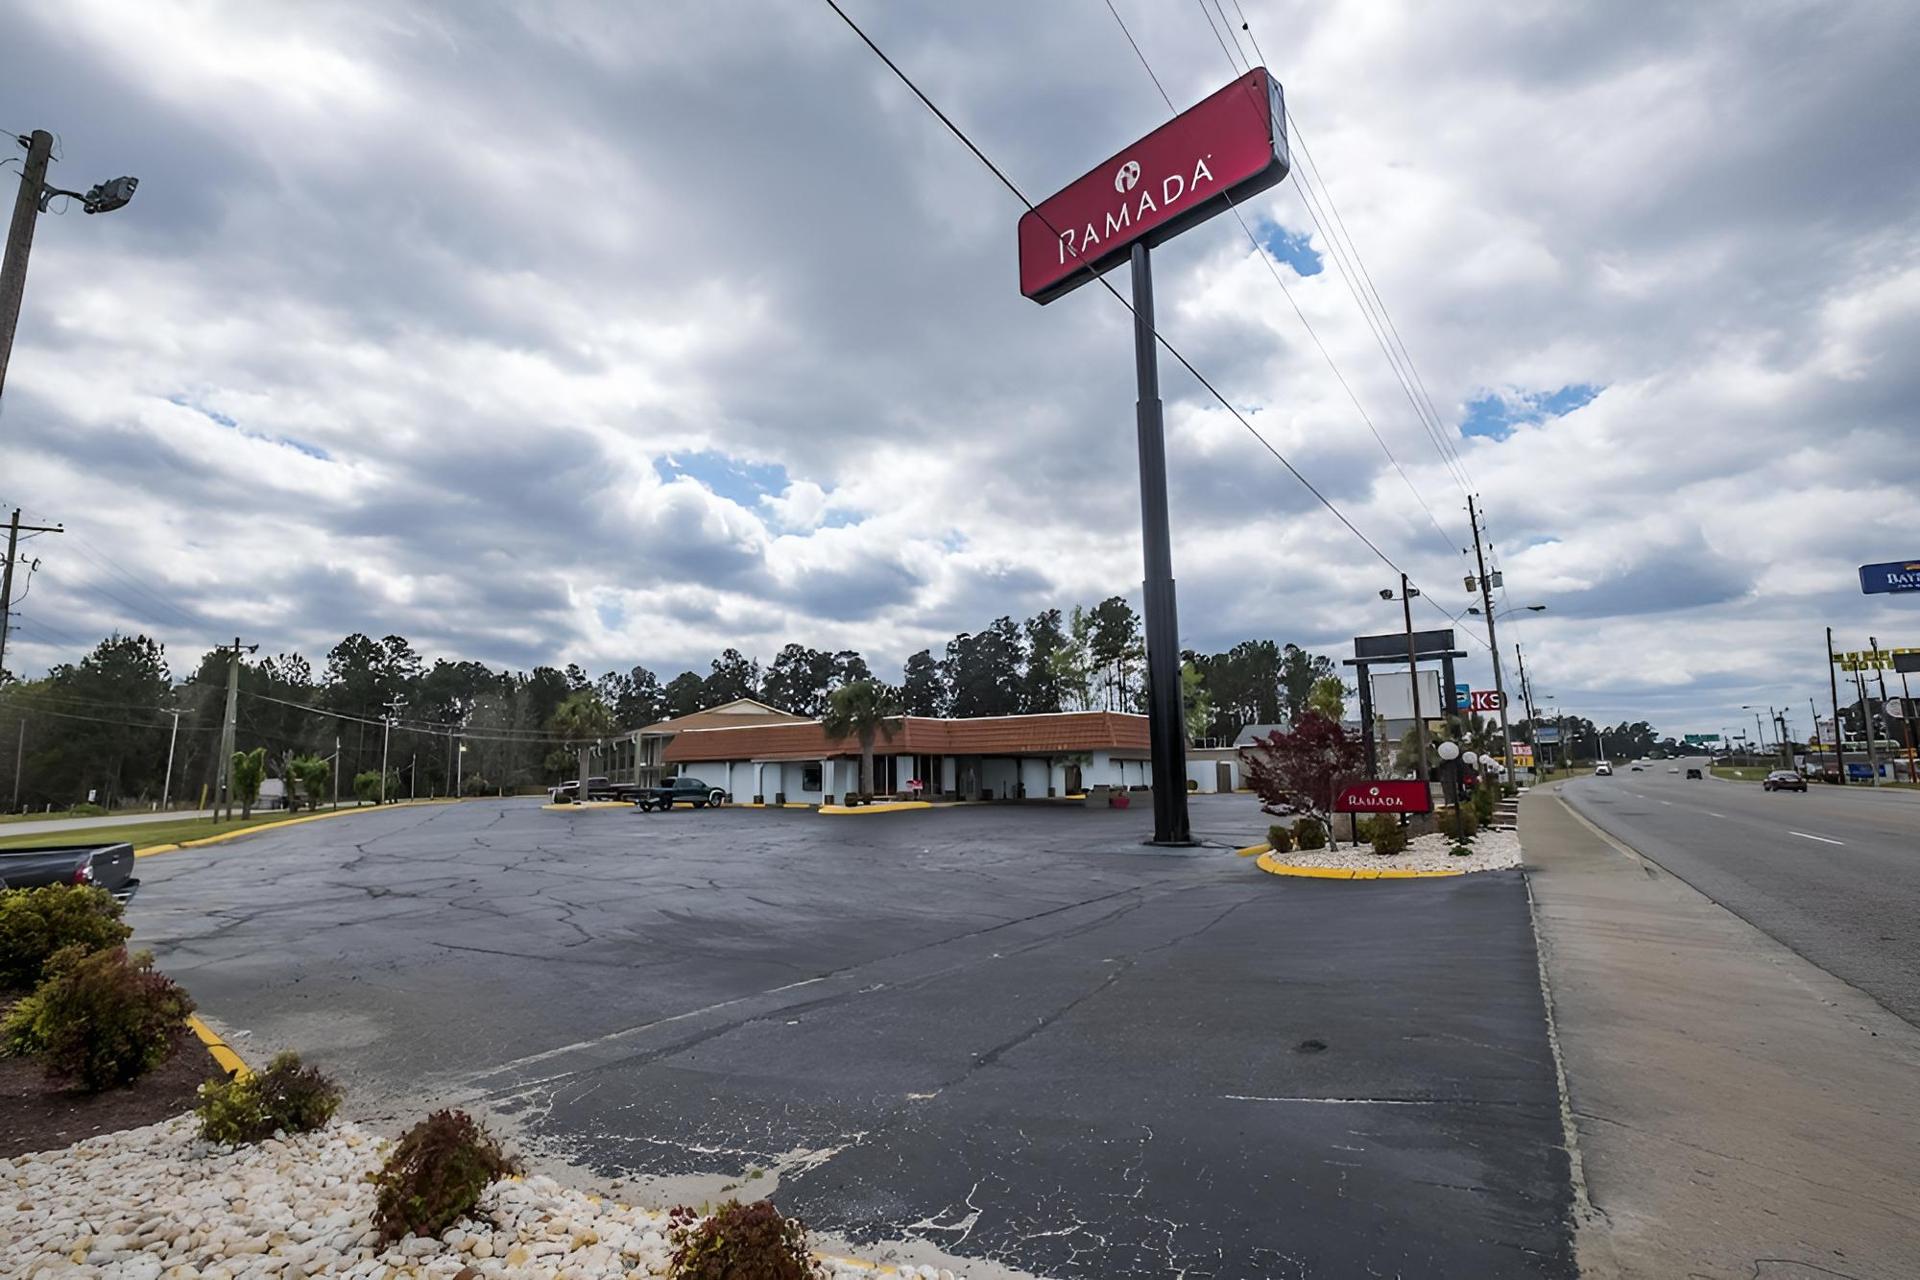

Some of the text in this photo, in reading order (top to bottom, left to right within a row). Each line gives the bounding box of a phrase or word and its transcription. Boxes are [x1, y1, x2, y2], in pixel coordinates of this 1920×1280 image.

[1058, 159, 1213, 264] RAMADA
[1471, 692, 1500, 709] KS
[1348, 795, 1403, 806] RAMADA
